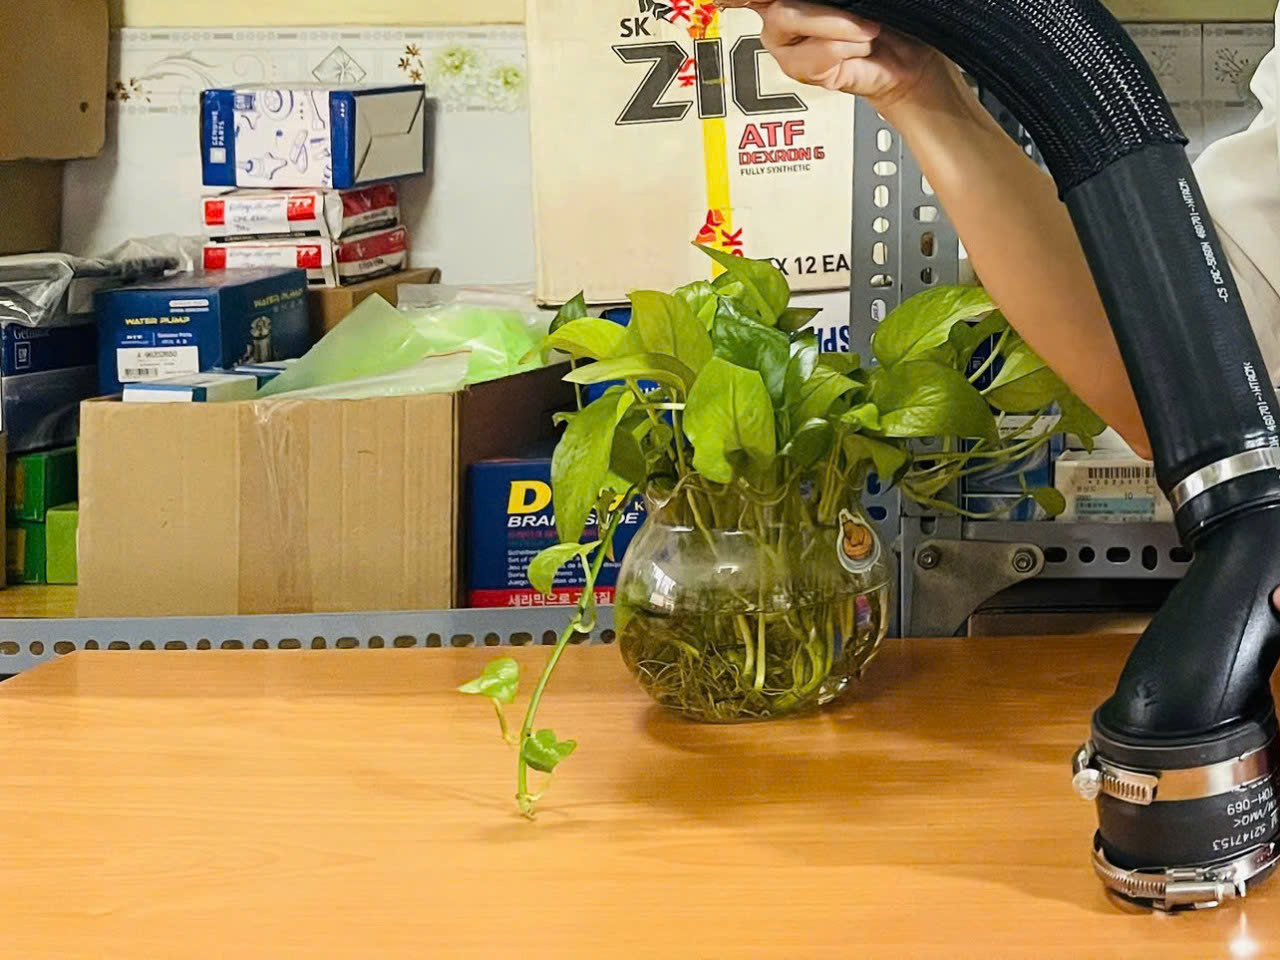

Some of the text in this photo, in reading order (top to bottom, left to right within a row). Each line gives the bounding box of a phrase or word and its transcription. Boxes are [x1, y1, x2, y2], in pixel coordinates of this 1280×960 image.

[620, 17, 650, 37] SK
[612, 34, 808, 126] ZIC
[738, 120, 805, 149] ATF
[739, 146, 825, 165] DEXRON 6
[740, 164, 811, 176] FULLY SYNTHETIC
[794, 256, 817, 275] 12
[822, 254, 850, 273] EA
[125, 316, 191, 325] WATER PUMP
